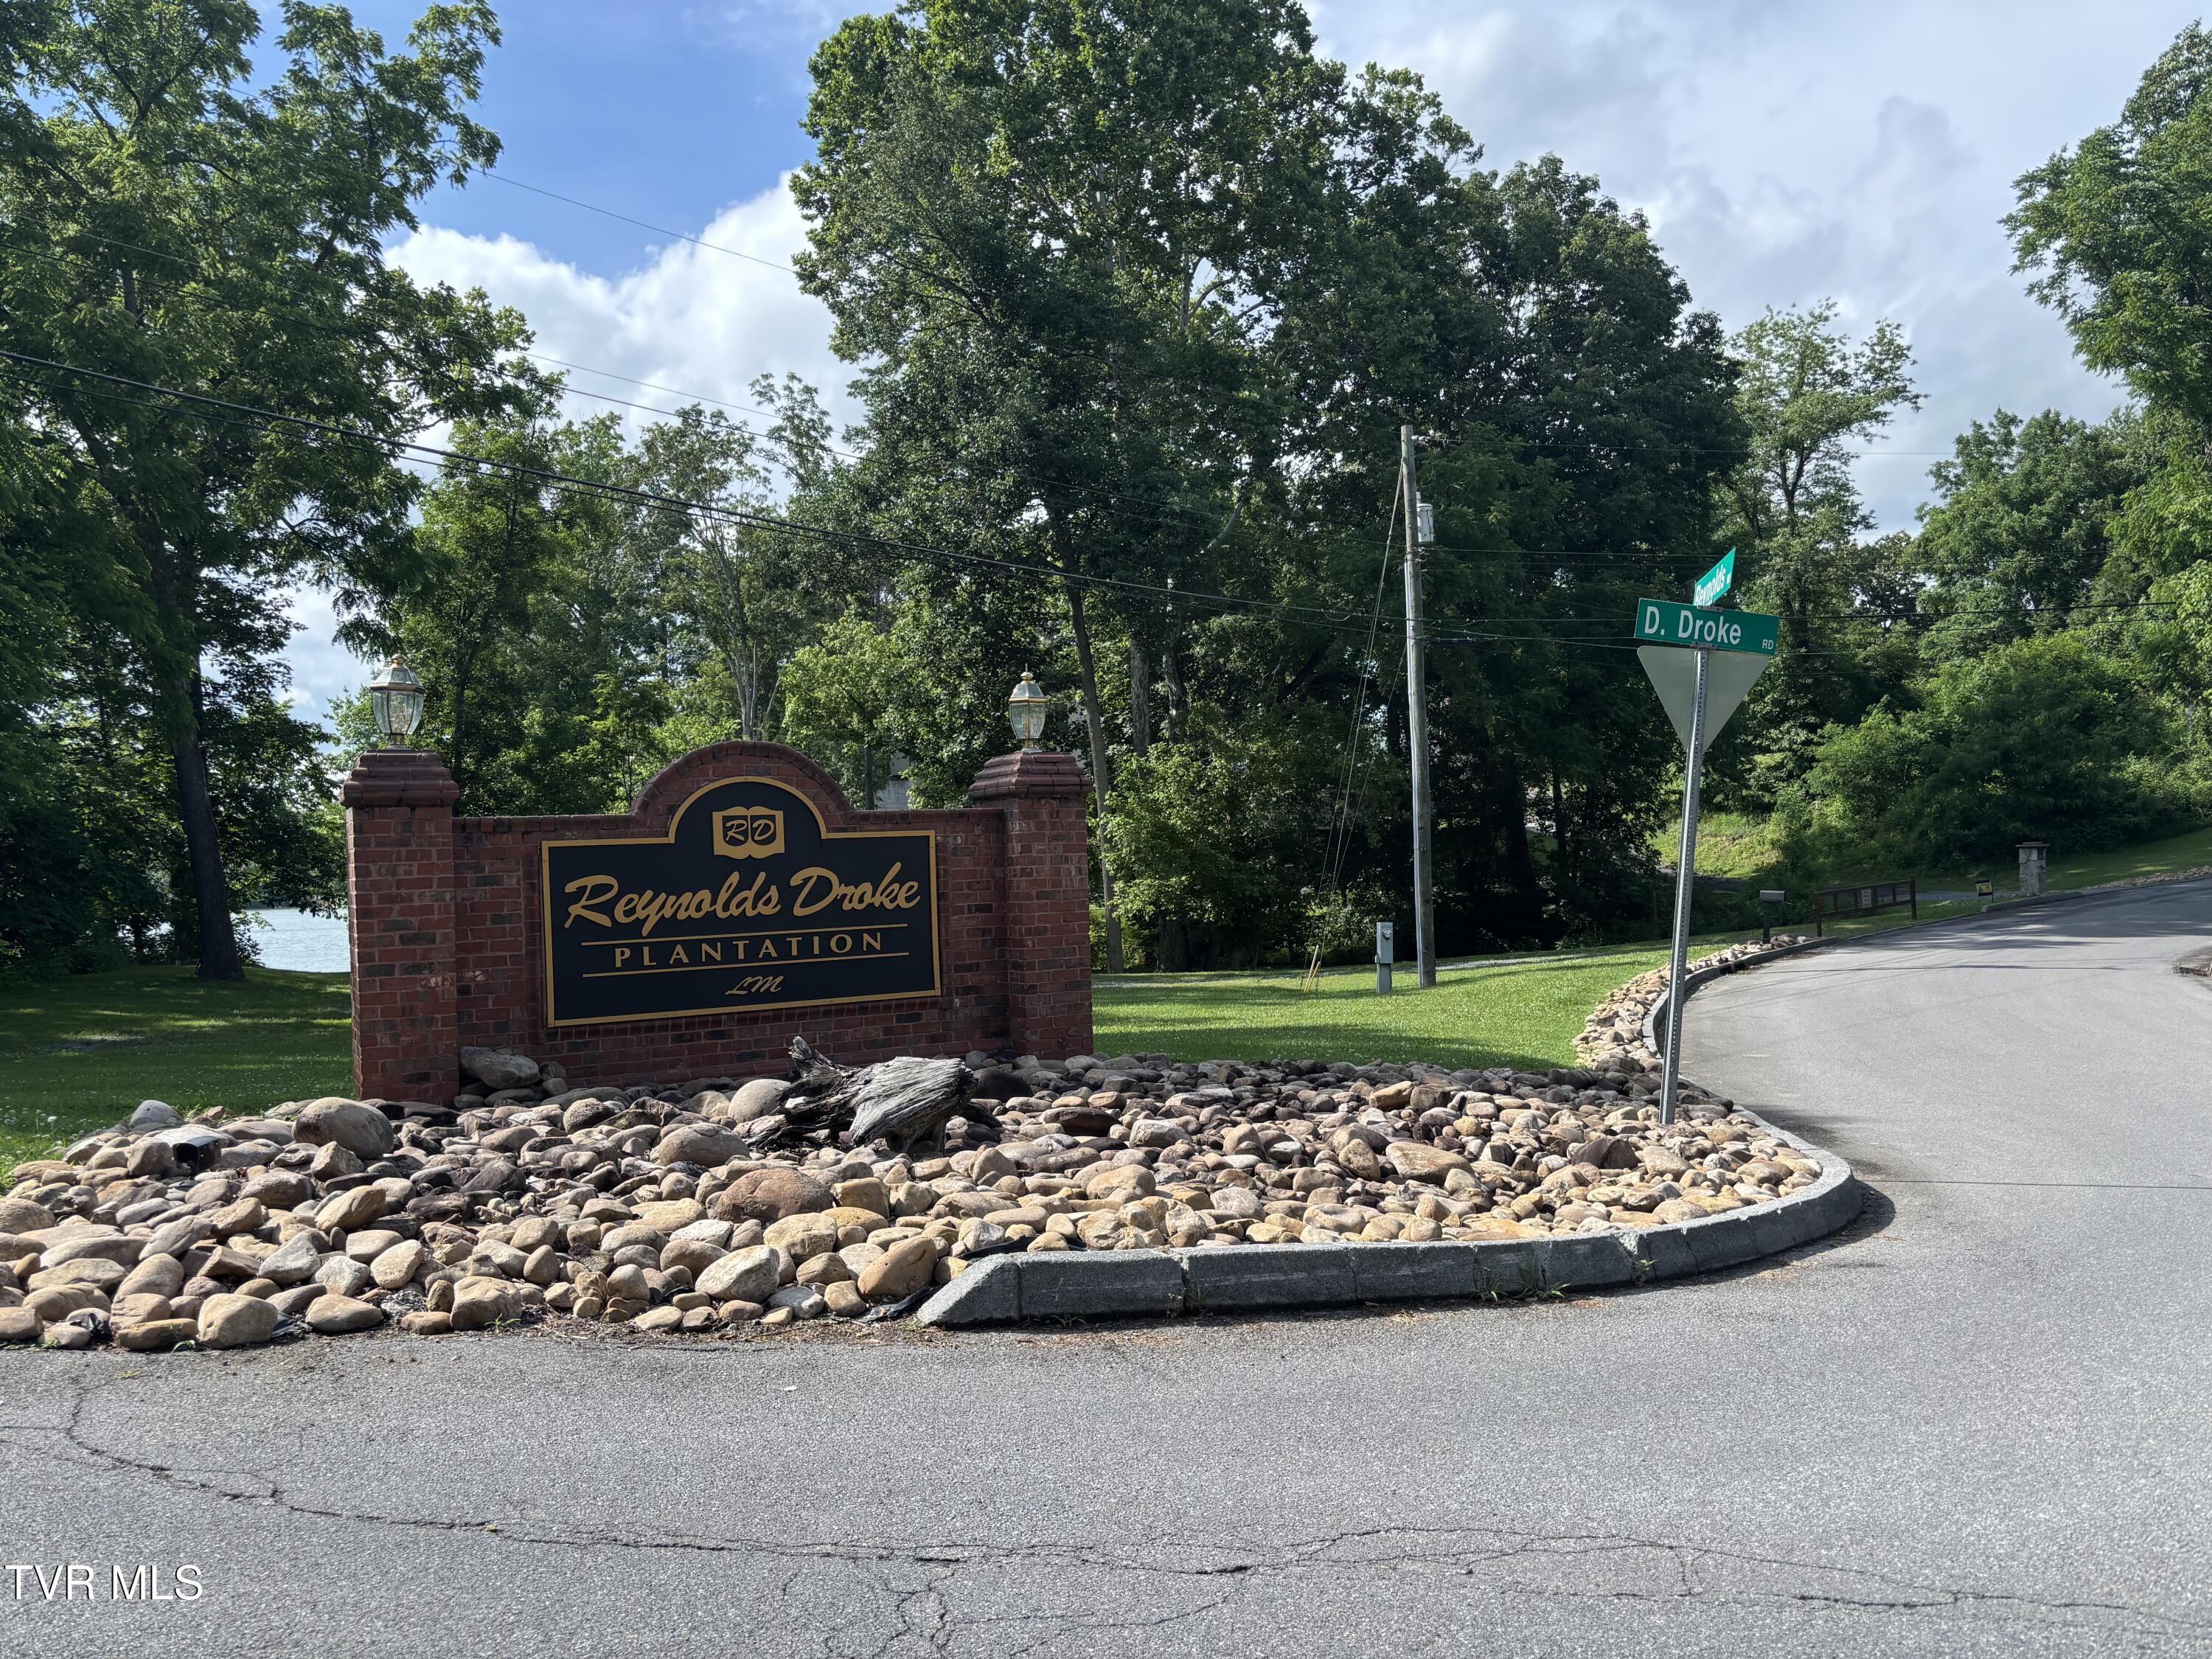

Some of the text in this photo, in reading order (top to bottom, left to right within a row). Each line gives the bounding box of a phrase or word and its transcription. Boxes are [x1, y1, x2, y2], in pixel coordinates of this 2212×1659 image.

[1696, 563, 1725, 605] Reynolds
[1644, 606, 1774, 650] D. Droke RD
[563, 861, 920, 936] Reynolds Droke
[614, 932, 882, 968] PLANTATION
